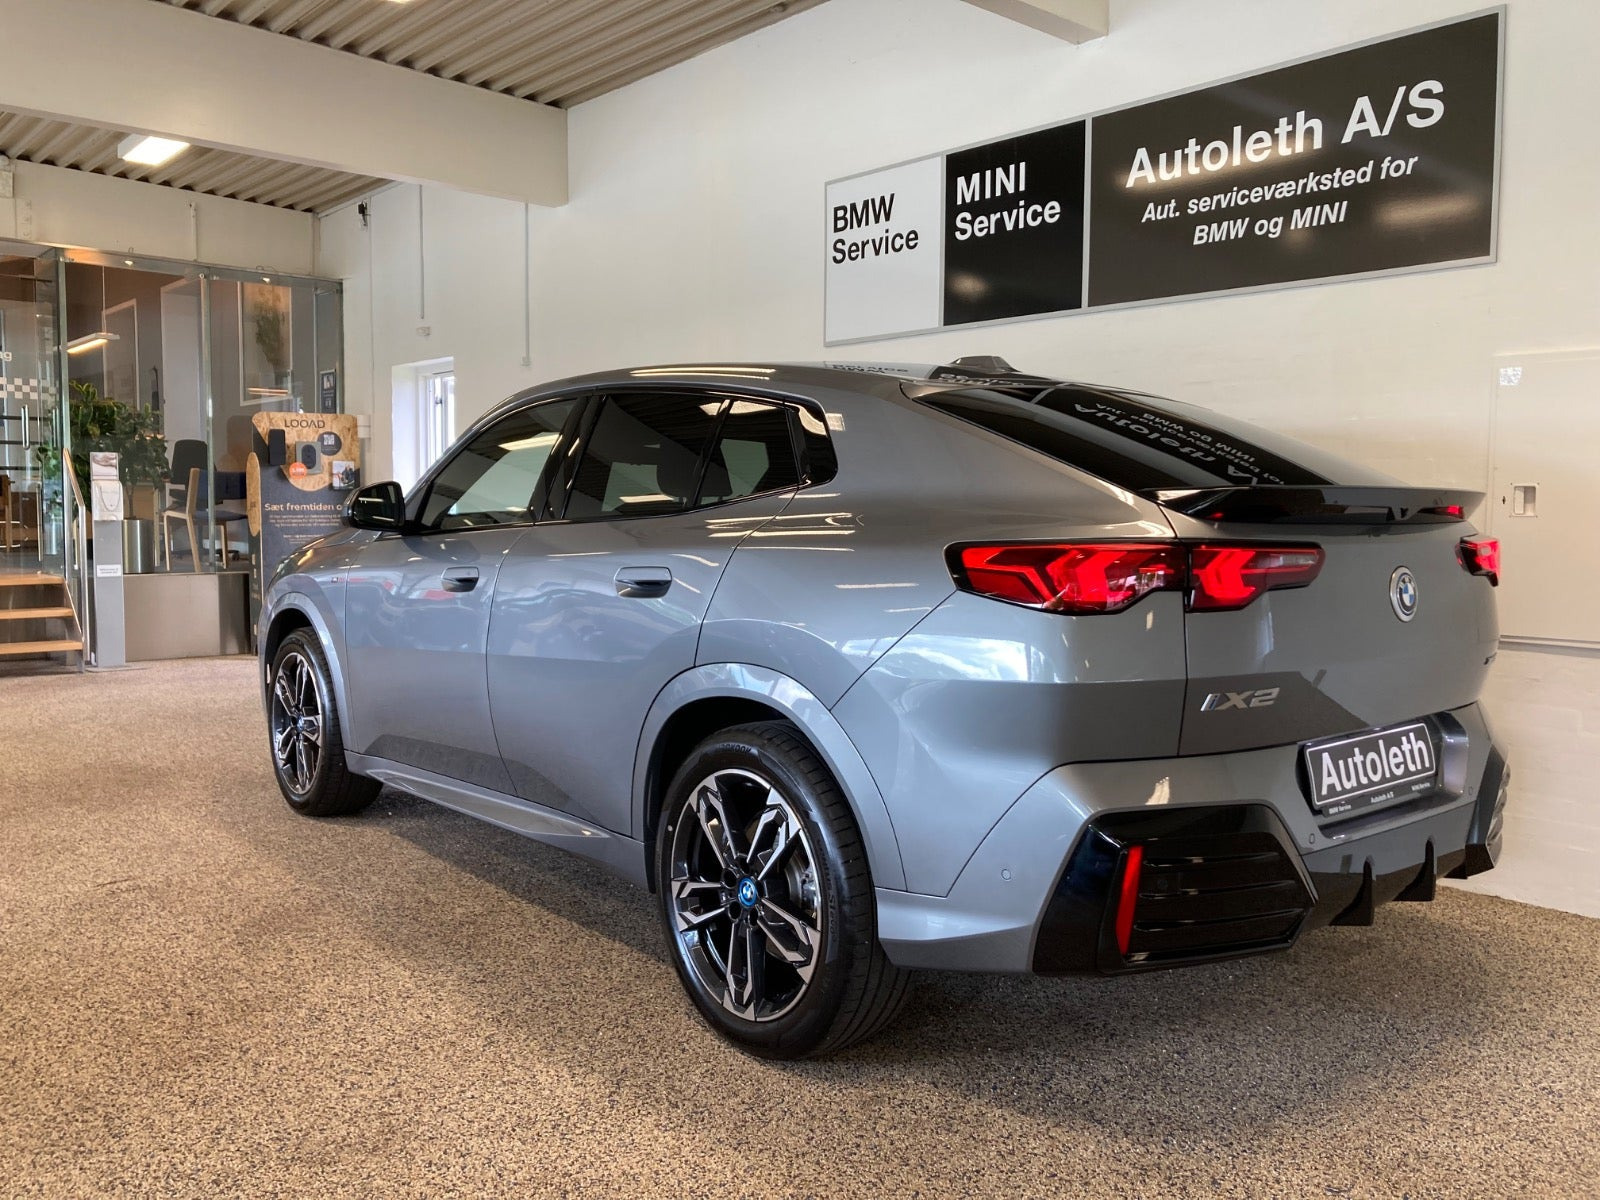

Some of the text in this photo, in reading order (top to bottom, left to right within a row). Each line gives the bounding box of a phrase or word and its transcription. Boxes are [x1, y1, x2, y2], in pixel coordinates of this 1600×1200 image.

[1124, 79, 1445, 189] Autoleth A/S
[956, 162, 1026, 206] MINI
[1141, 156, 1419, 223] Aut. serviceværksted for
[833, 193, 895, 234] BMW
[954, 199, 1061, 241] Service
[1193, 200, 1348, 246] BMW og MINI
[832, 229, 919, 265] Service
[286, 502, 334, 511] fremtiden
[1321, 731, 1431, 796] Autoleth
